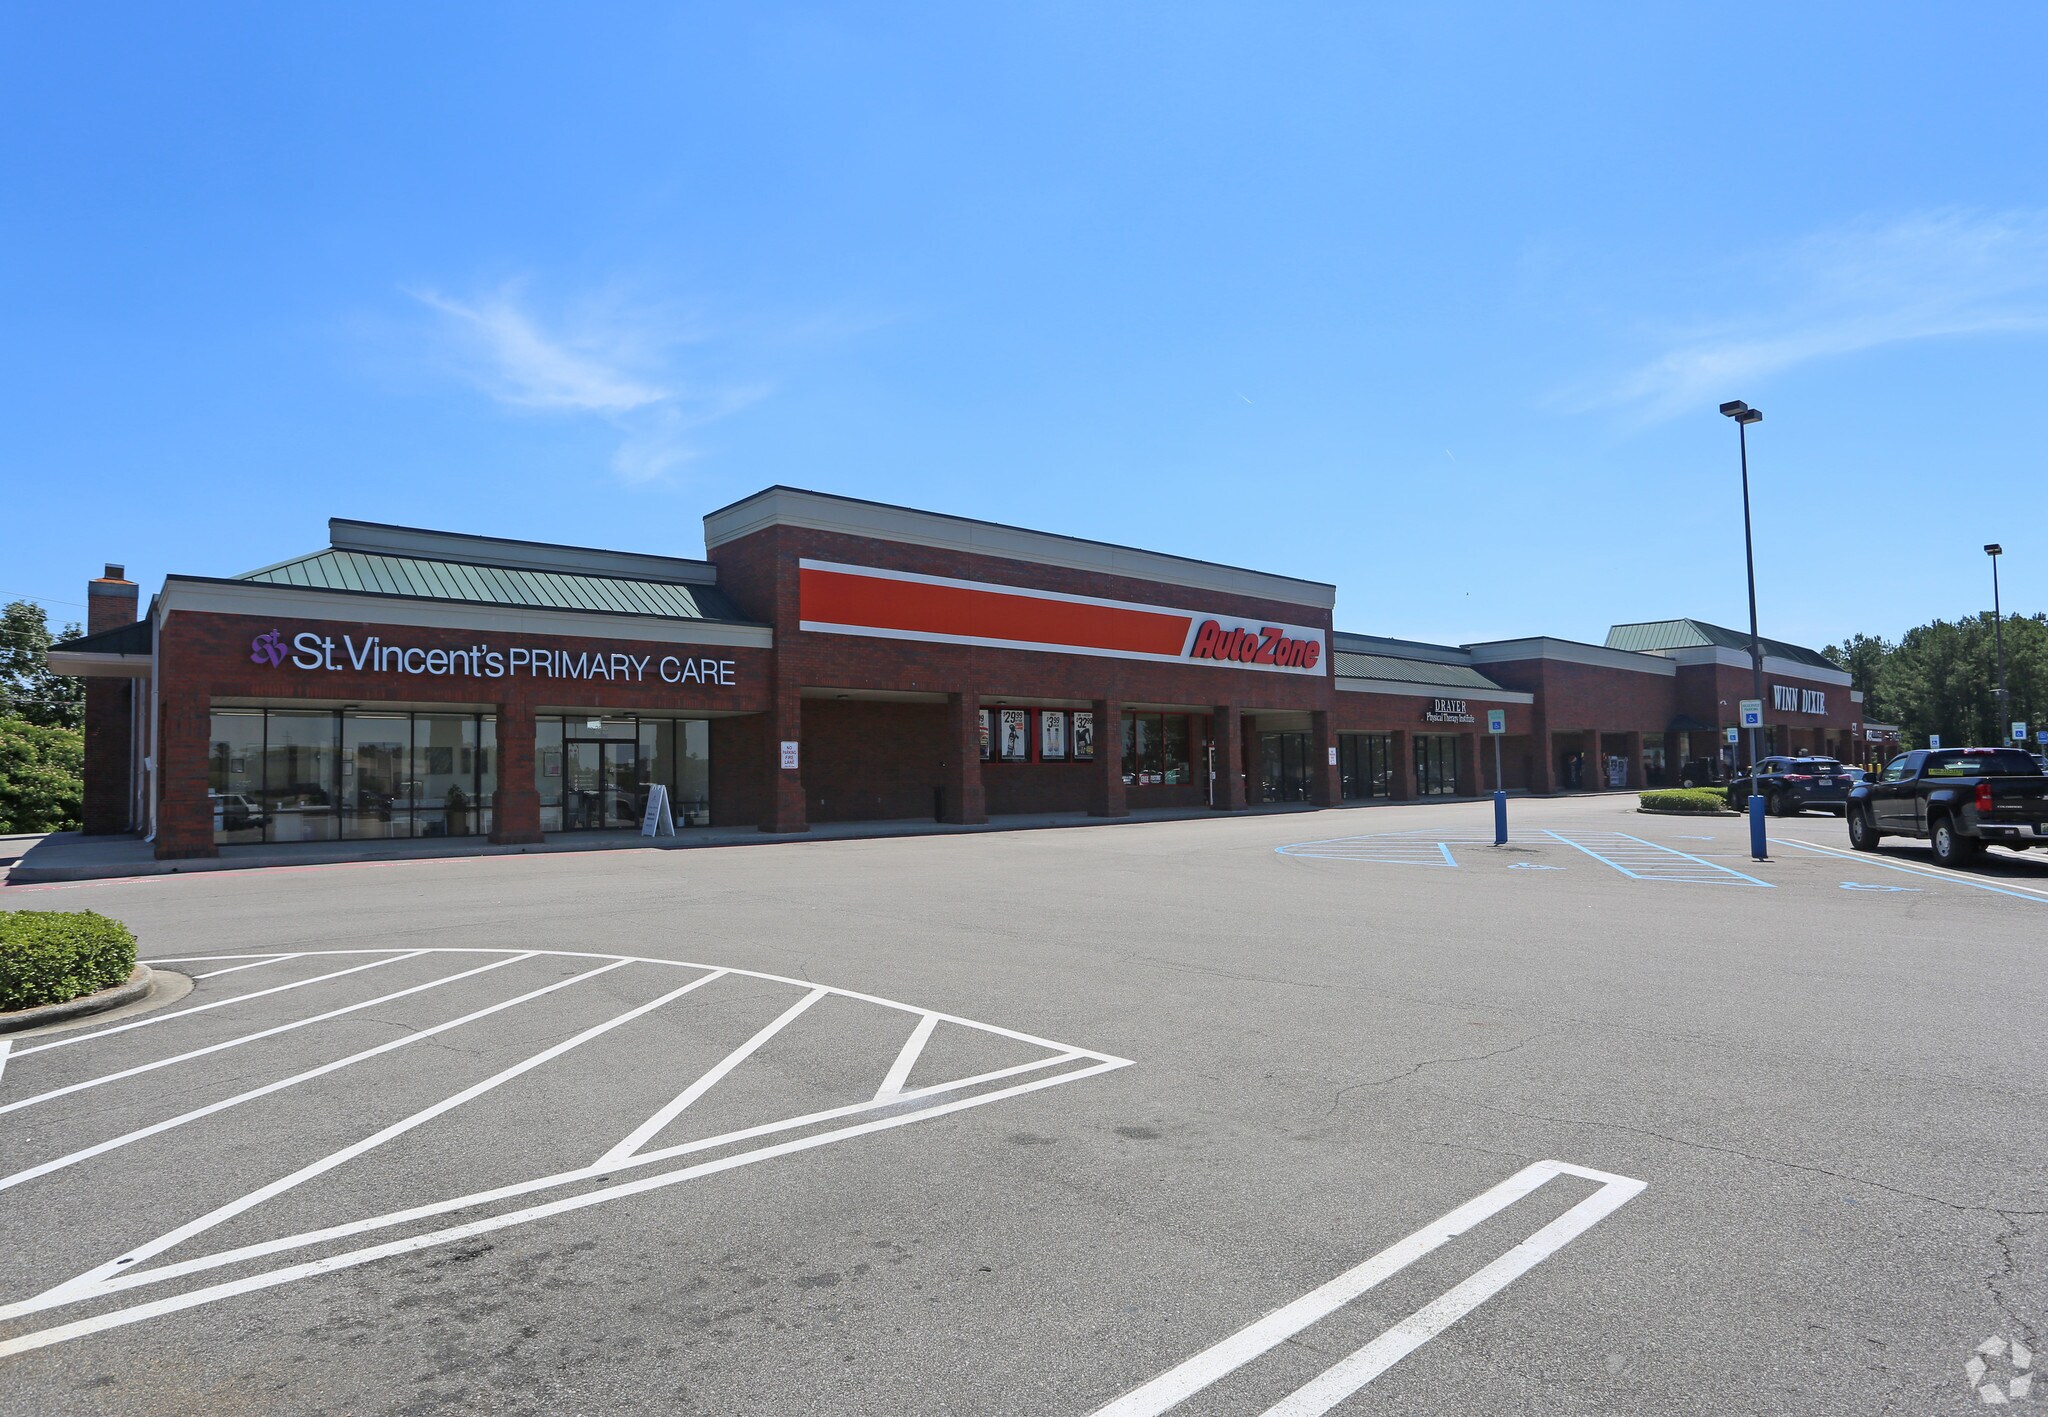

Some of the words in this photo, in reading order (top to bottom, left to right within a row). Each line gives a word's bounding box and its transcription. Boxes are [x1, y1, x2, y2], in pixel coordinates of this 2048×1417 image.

[1190, 619, 1320, 669] AutoZone
[292, 632, 343, 671] St.
[343, 634, 505, 678] Vincent's
[509, 648, 650, 682] PRIMARY
[659, 655, 736, 686] CARE
[1435, 700, 1466, 712] DRAYER
[1774, 685, 1798, 711] WINN
[1802, 689, 1824, 714] DIXIE
[1426, 711, 1443, 723] Physical
[1443, 713, 1459, 724] Therapy
